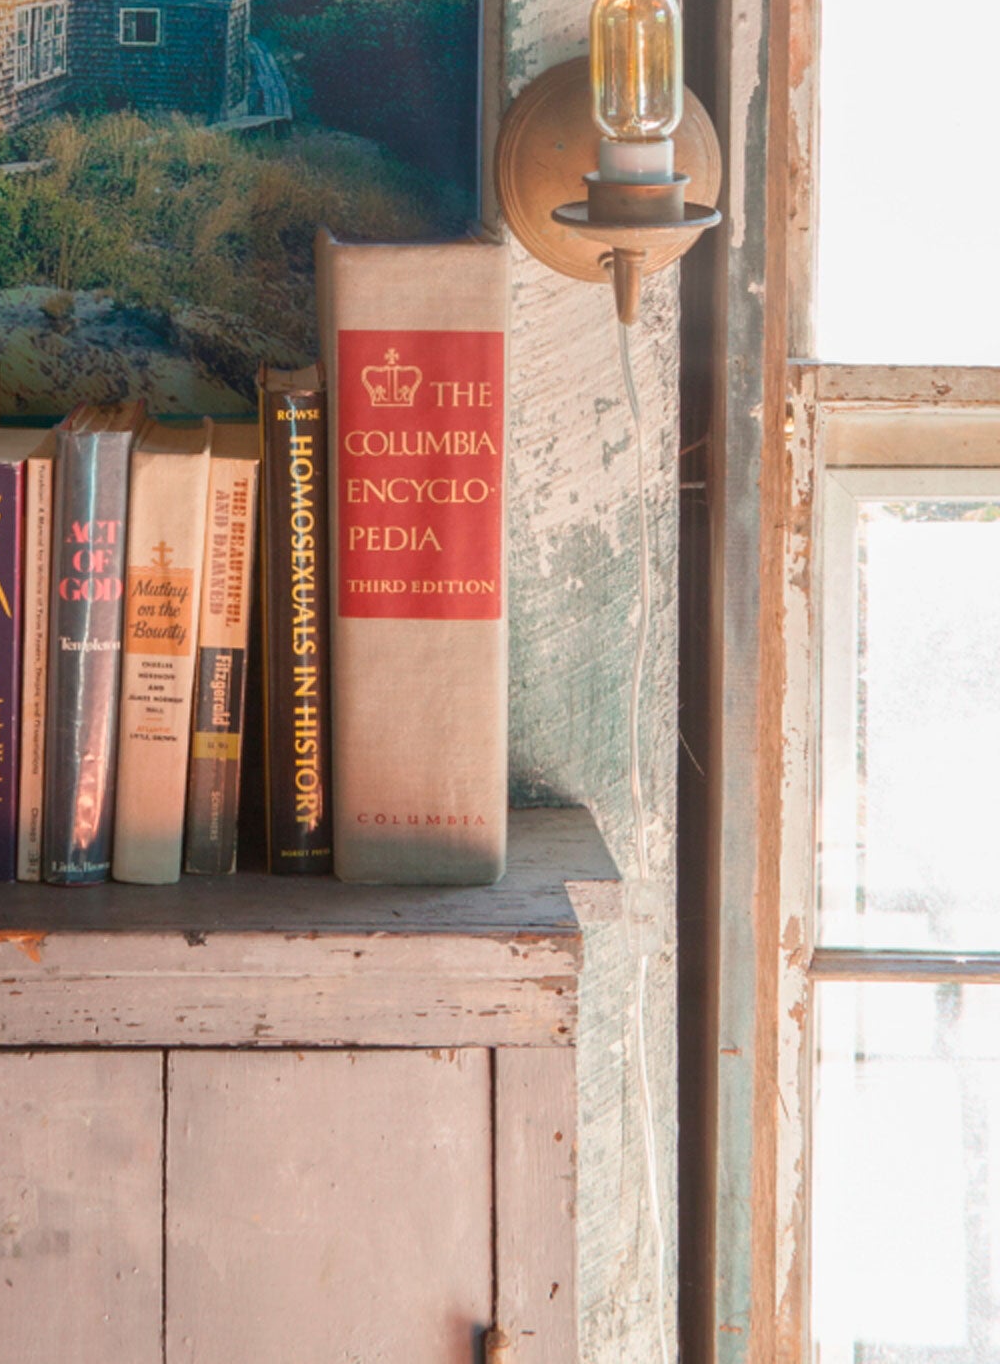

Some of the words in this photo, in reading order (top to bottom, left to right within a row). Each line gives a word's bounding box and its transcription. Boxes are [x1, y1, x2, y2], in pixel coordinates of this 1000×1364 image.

[429, 381, 492, 408] THE
[276, 409, 320, 421] ROWSE
[344, 430, 497, 457] COLUMBIA
[214, 489, 230, 528] AND
[231, 478, 248, 517] THE
[66, 520, 121, 545] ACT
[290, 435, 318, 656] HOMOSEXUALS
[349, 525, 443, 552] PEDIA
[72, 548, 113, 573] OF
[209, 533, 228, 615] DAMNED
[225, 522, 246, 628] BEAUTIFUL
[347, 580, 406, 594] THIRD
[410, 579, 495, 594] EDITION
[59, 577, 124, 602] GOD
[131, 578, 188, 603] Mutiny
[138, 604, 156, 616] on
[158, 601, 181, 617] the
[60, 636, 121, 653] Templeton
[129, 622, 187, 646] Bounty
[209, 654, 232, 726] Fitzgerald
[292, 665, 318, 697] IN
[293, 706, 320, 825] HISTORY
[356, 812, 486, 826] COLUMBIA
